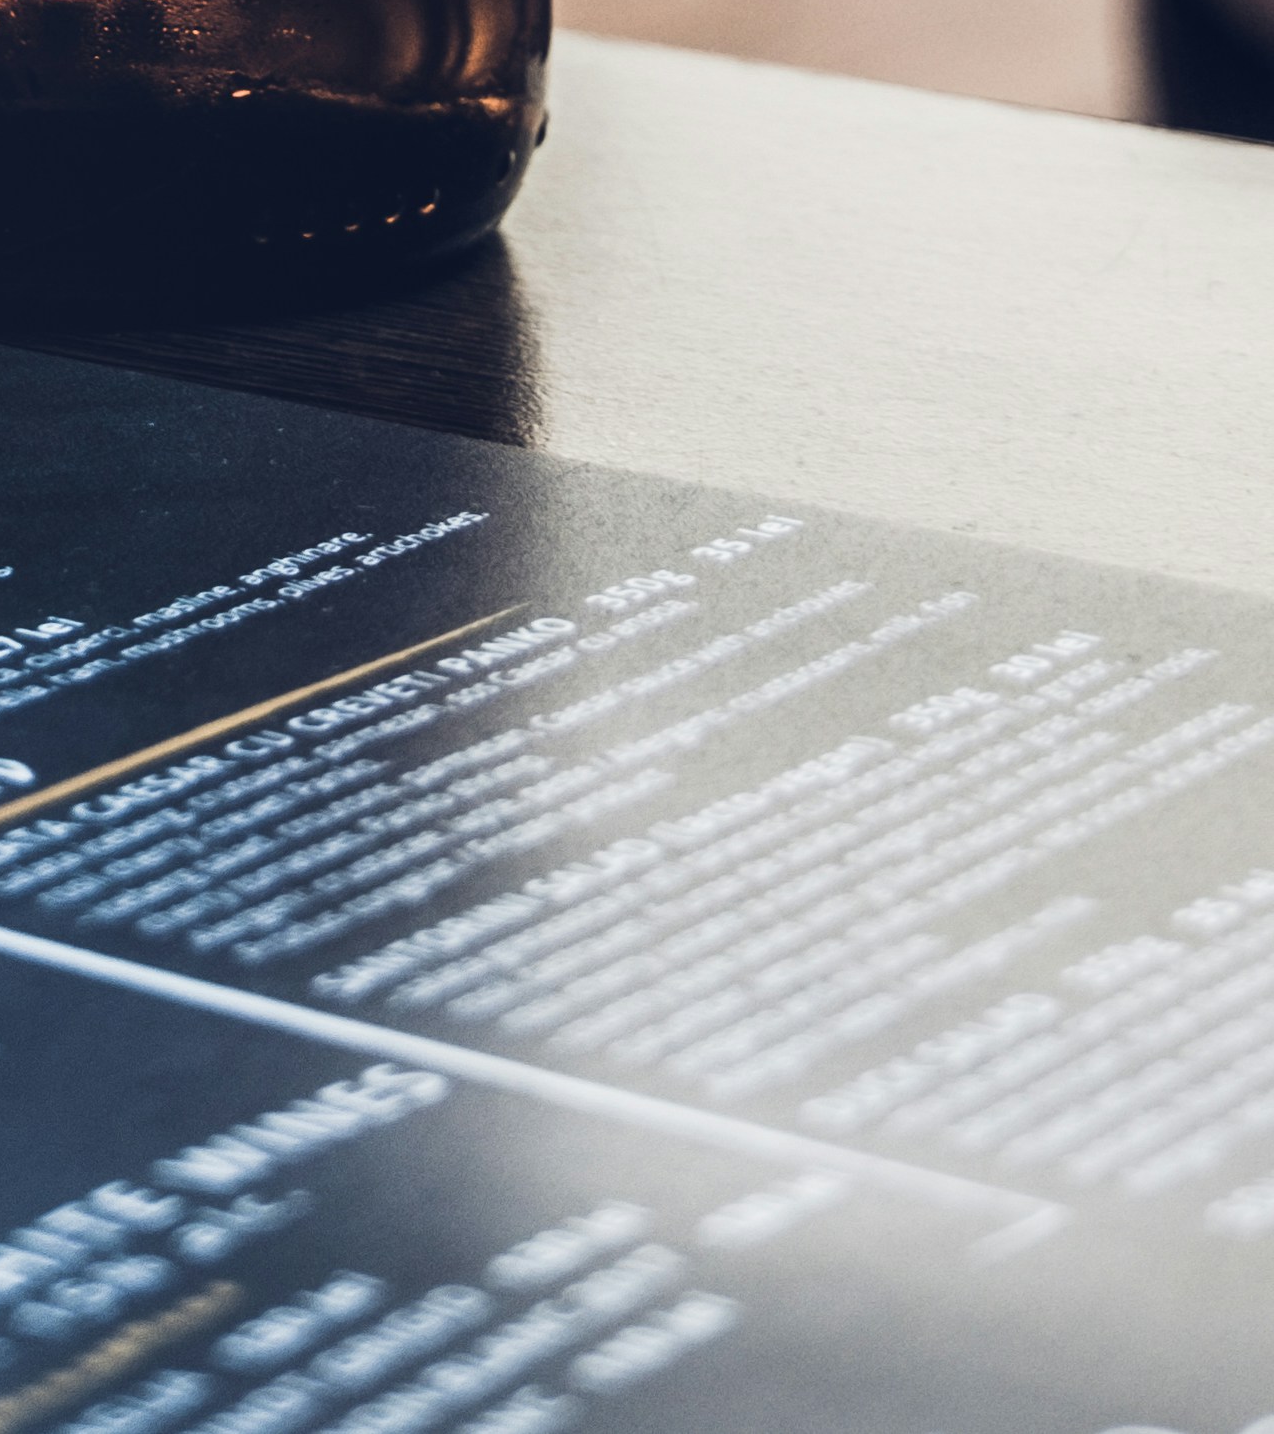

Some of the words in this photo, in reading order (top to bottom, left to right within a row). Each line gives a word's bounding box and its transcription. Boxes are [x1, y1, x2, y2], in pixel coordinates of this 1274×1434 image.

[238, 531, 372, 585] anghinare.
[355, 510, 489, 566] artichokes.
[287, 670, 448, 732] CREVETI
[436, 617, 575, 674] PANKO
[582, 568, 695, 612] 350g
[692, 534, 751, 564] 35
